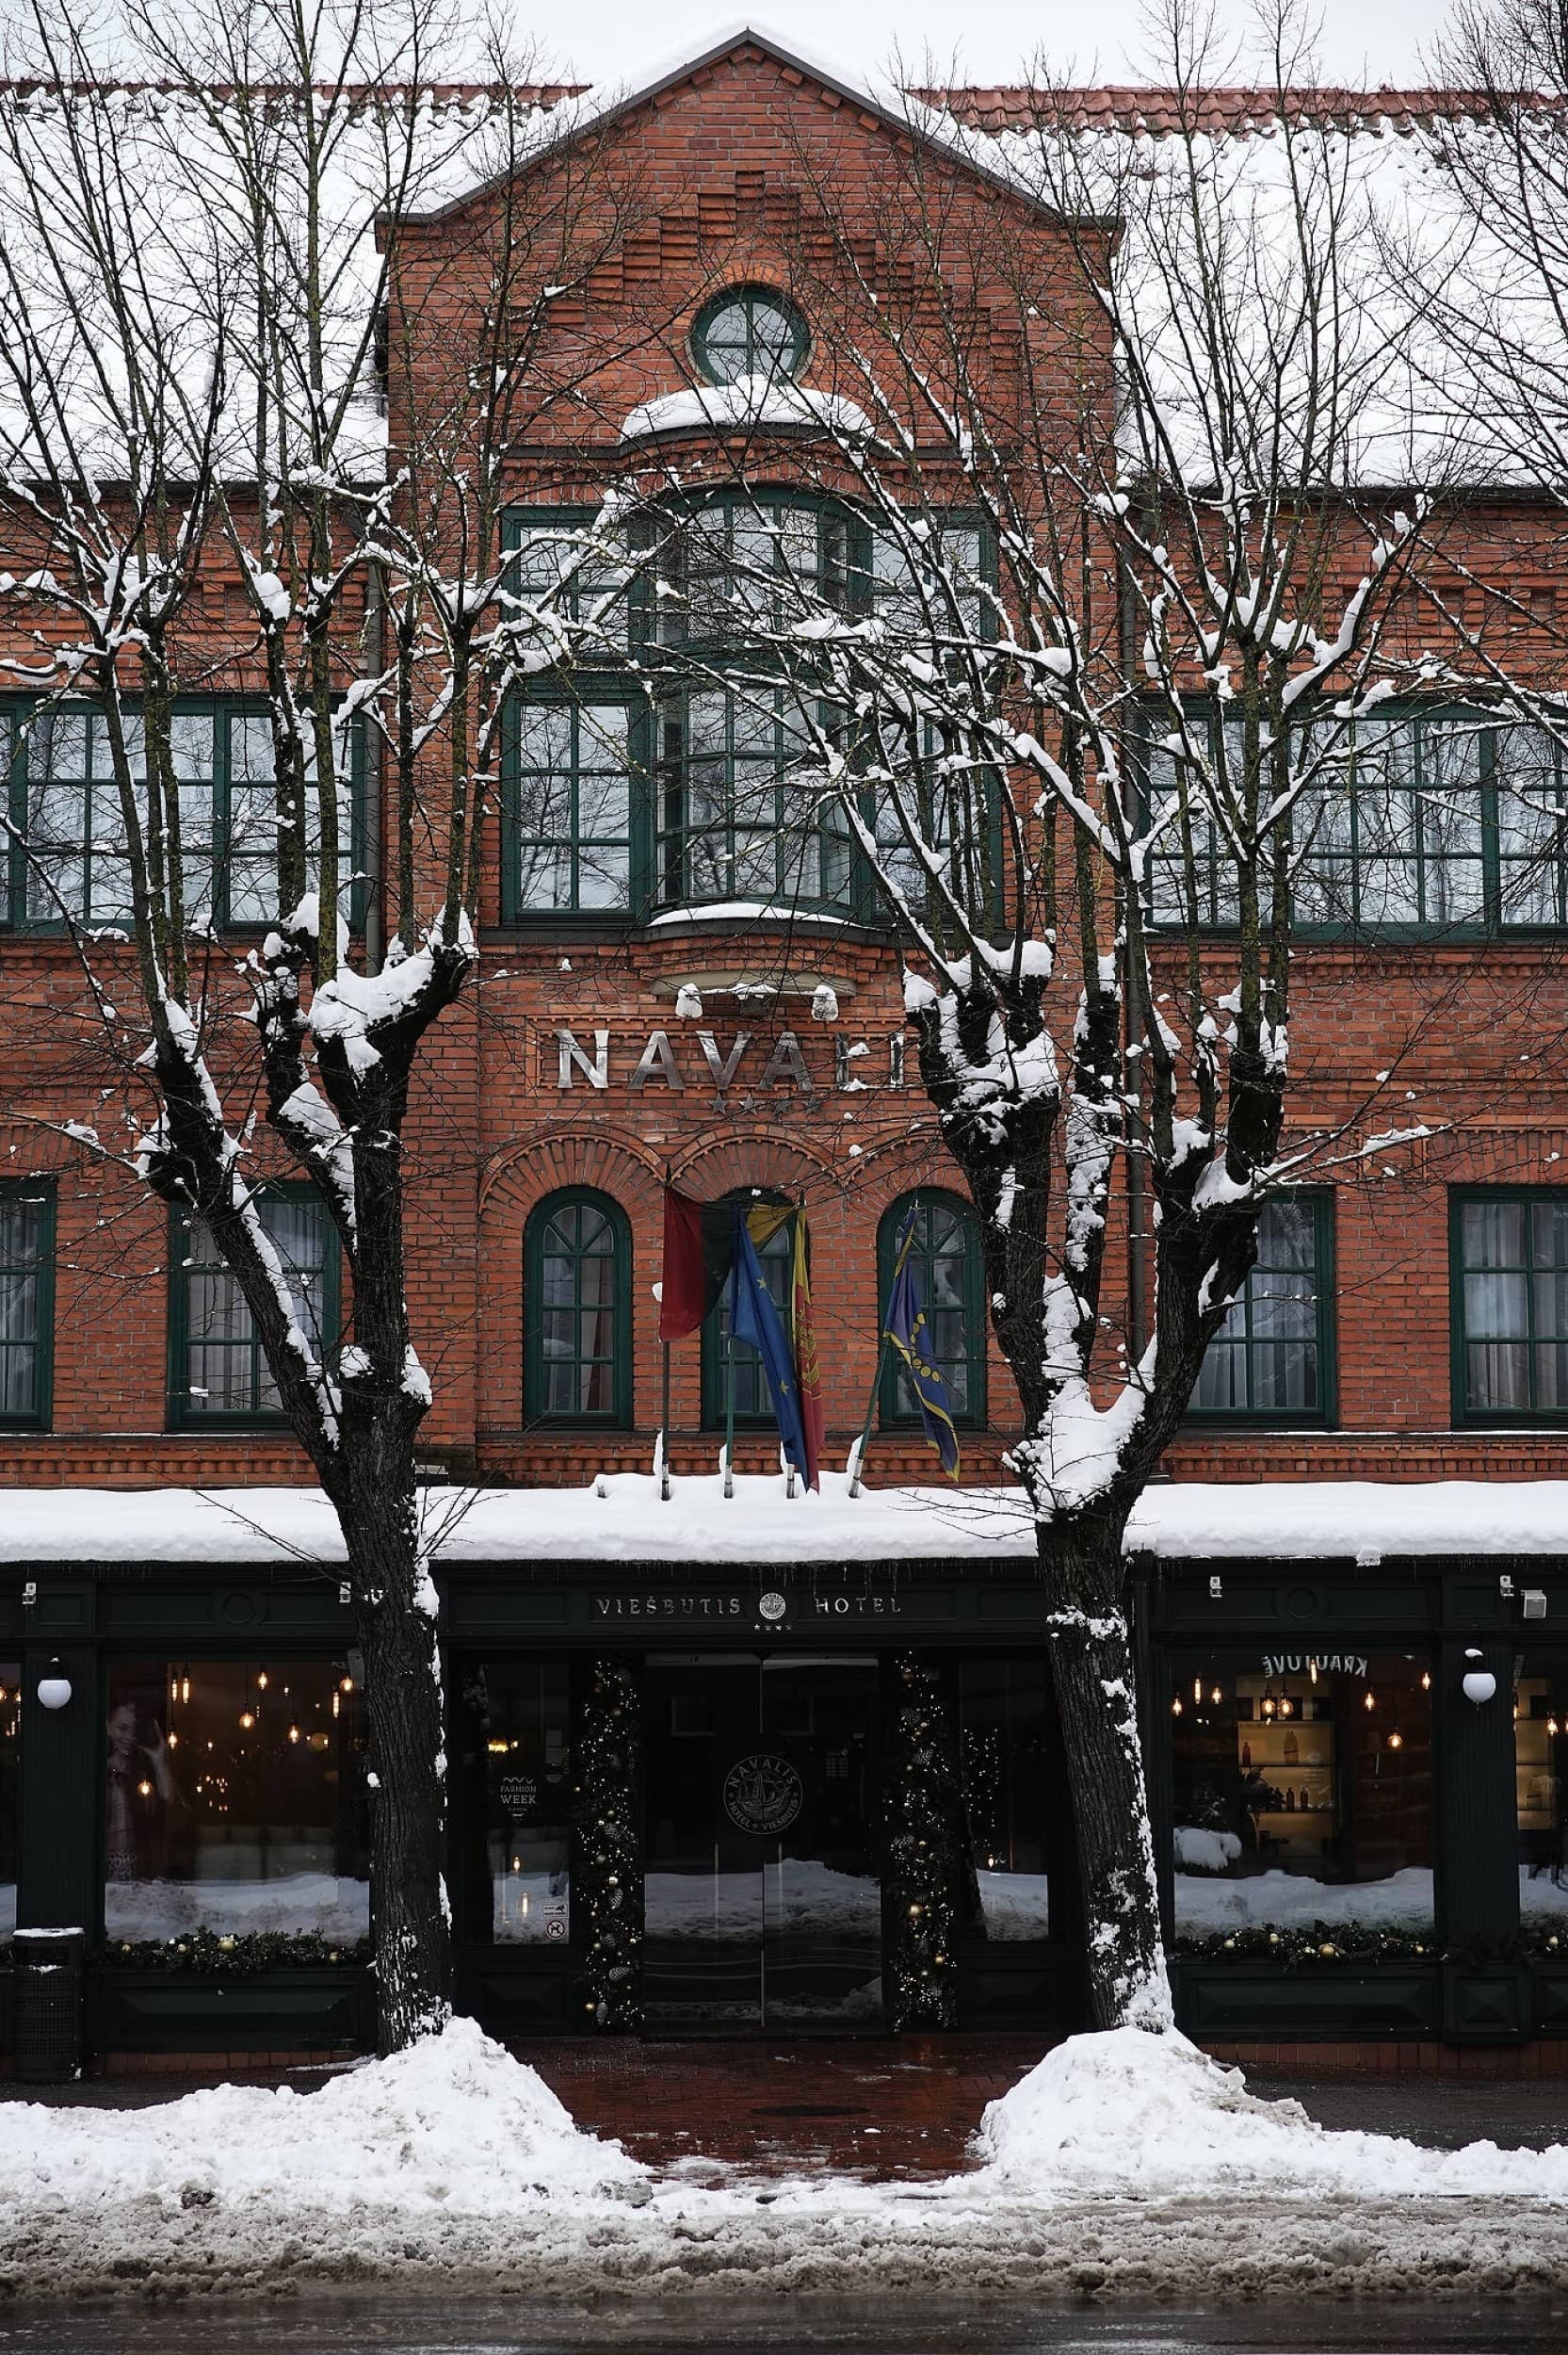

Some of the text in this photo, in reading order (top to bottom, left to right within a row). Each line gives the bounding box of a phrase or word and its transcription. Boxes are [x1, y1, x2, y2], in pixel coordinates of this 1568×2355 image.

[553, 1029, 904, 1092] NAVALI
[595, 1595, 741, 1615] VIEŠBUTIS
[815, 1598, 902, 1614] HOTEL
[728, 1758, 798, 1788] NAVALIS
[500, 1795, 536, 1804] WEEK
[729, 1801, 751, 1828] HOTEL
